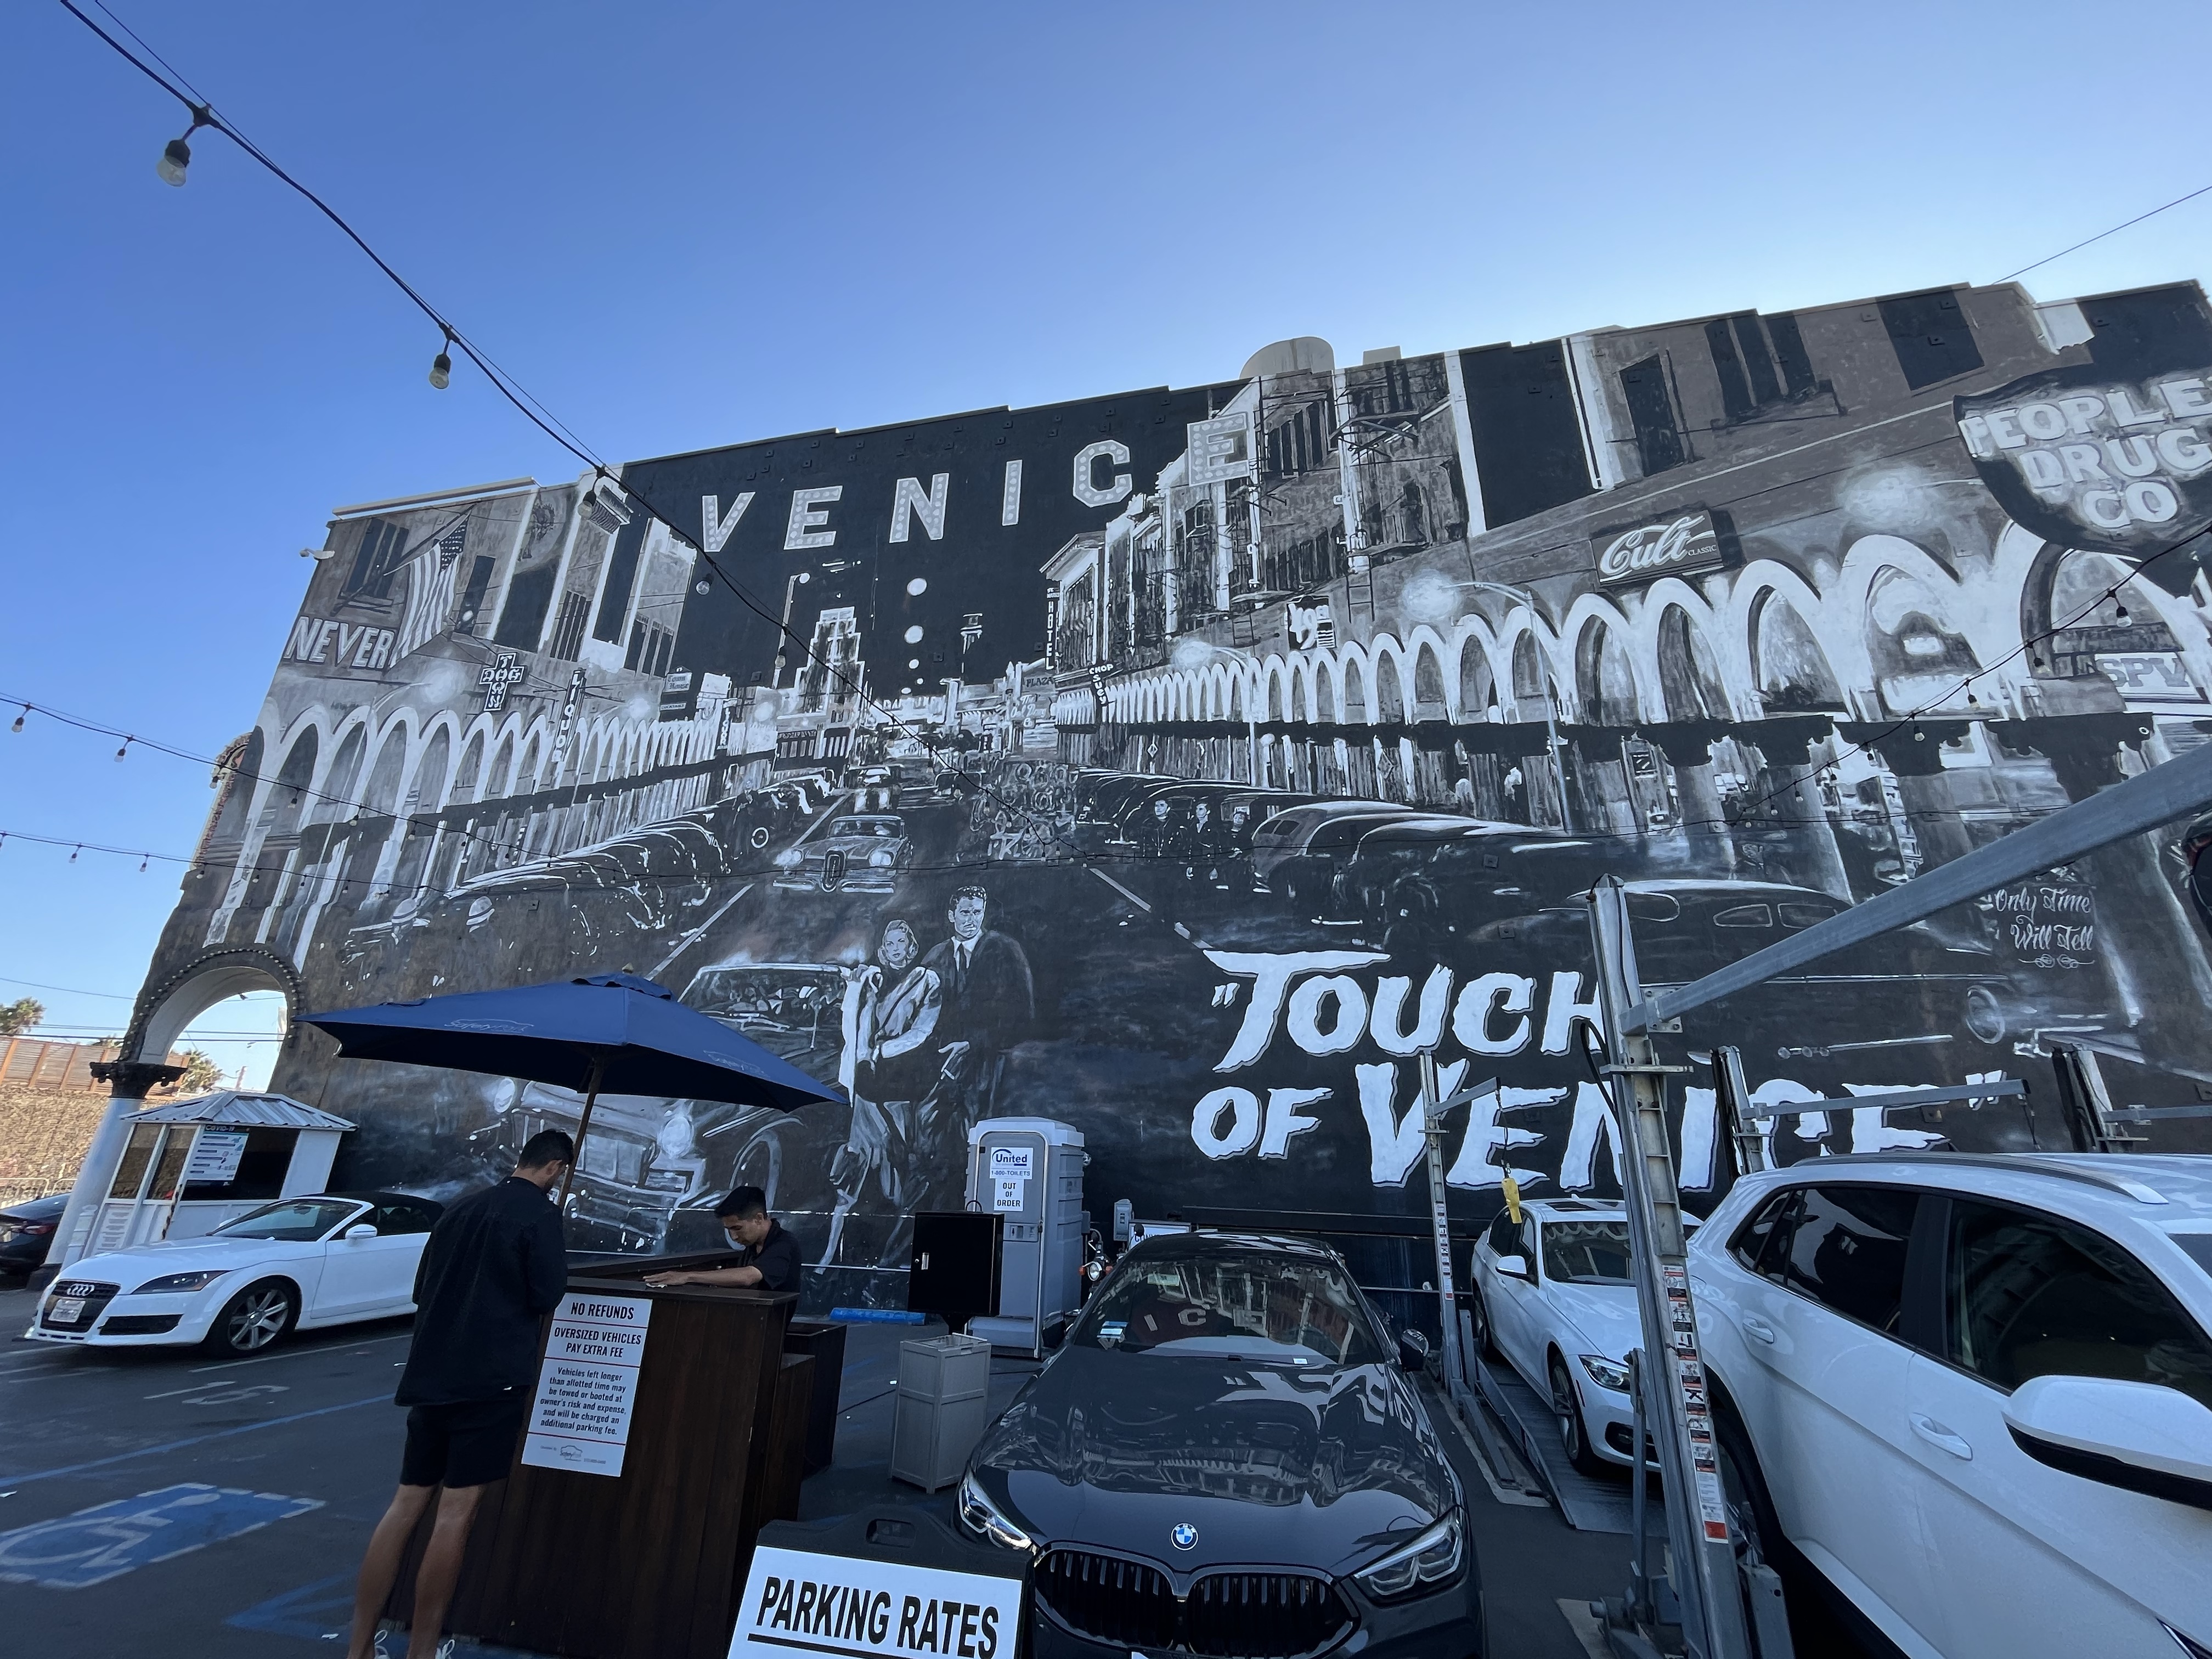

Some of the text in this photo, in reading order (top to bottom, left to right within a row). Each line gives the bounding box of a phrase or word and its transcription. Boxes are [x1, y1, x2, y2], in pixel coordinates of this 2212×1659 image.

[2020, 428, 2212, 487] DRUG
[701, 413, 1250, 552] VENICE
[2084, 481, 2178, 527] CO
[1600, 515, 1705, 575] Cult
[1688, 545, 1717, 556] CLASSIC
[283, 616, 395, 669] NEVER
[1089, 664, 1114, 674] CHOP
[1026, 676, 1054, 687] PLAZA
[551, 674, 580, 762] LIQUOR
[1994, 887, 2091, 924] Only Time
[2010, 924, 2093, 951] Will Tell
[1191, 1086, 1334, 1160] OF
[996, 1154, 1028, 1163] United
[571, 1302, 634, 1319] NO REFUNDS
[554, 1327, 641, 1345] OVERSIZED VEHICLES
[566, 1342, 624, 1358] PAY EXTRA FEE
[558, 1367, 623, 1381] Vehicles left longer
[550, 1377, 627, 1393] than allotted time may
[549, 1387, 557, 1395] be
[558, 1389, 579, 1397] towed
[590, 1391, 613, 1401] booted
[540, 1398, 566, 1407] owner's
[583, 1402, 596, 1410] and
[581, 1413, 610, 1423] charged
[540, 1419, 618, 1435] additional parking fee.
[755, 1576, 998, 1659] PARKING RATES
